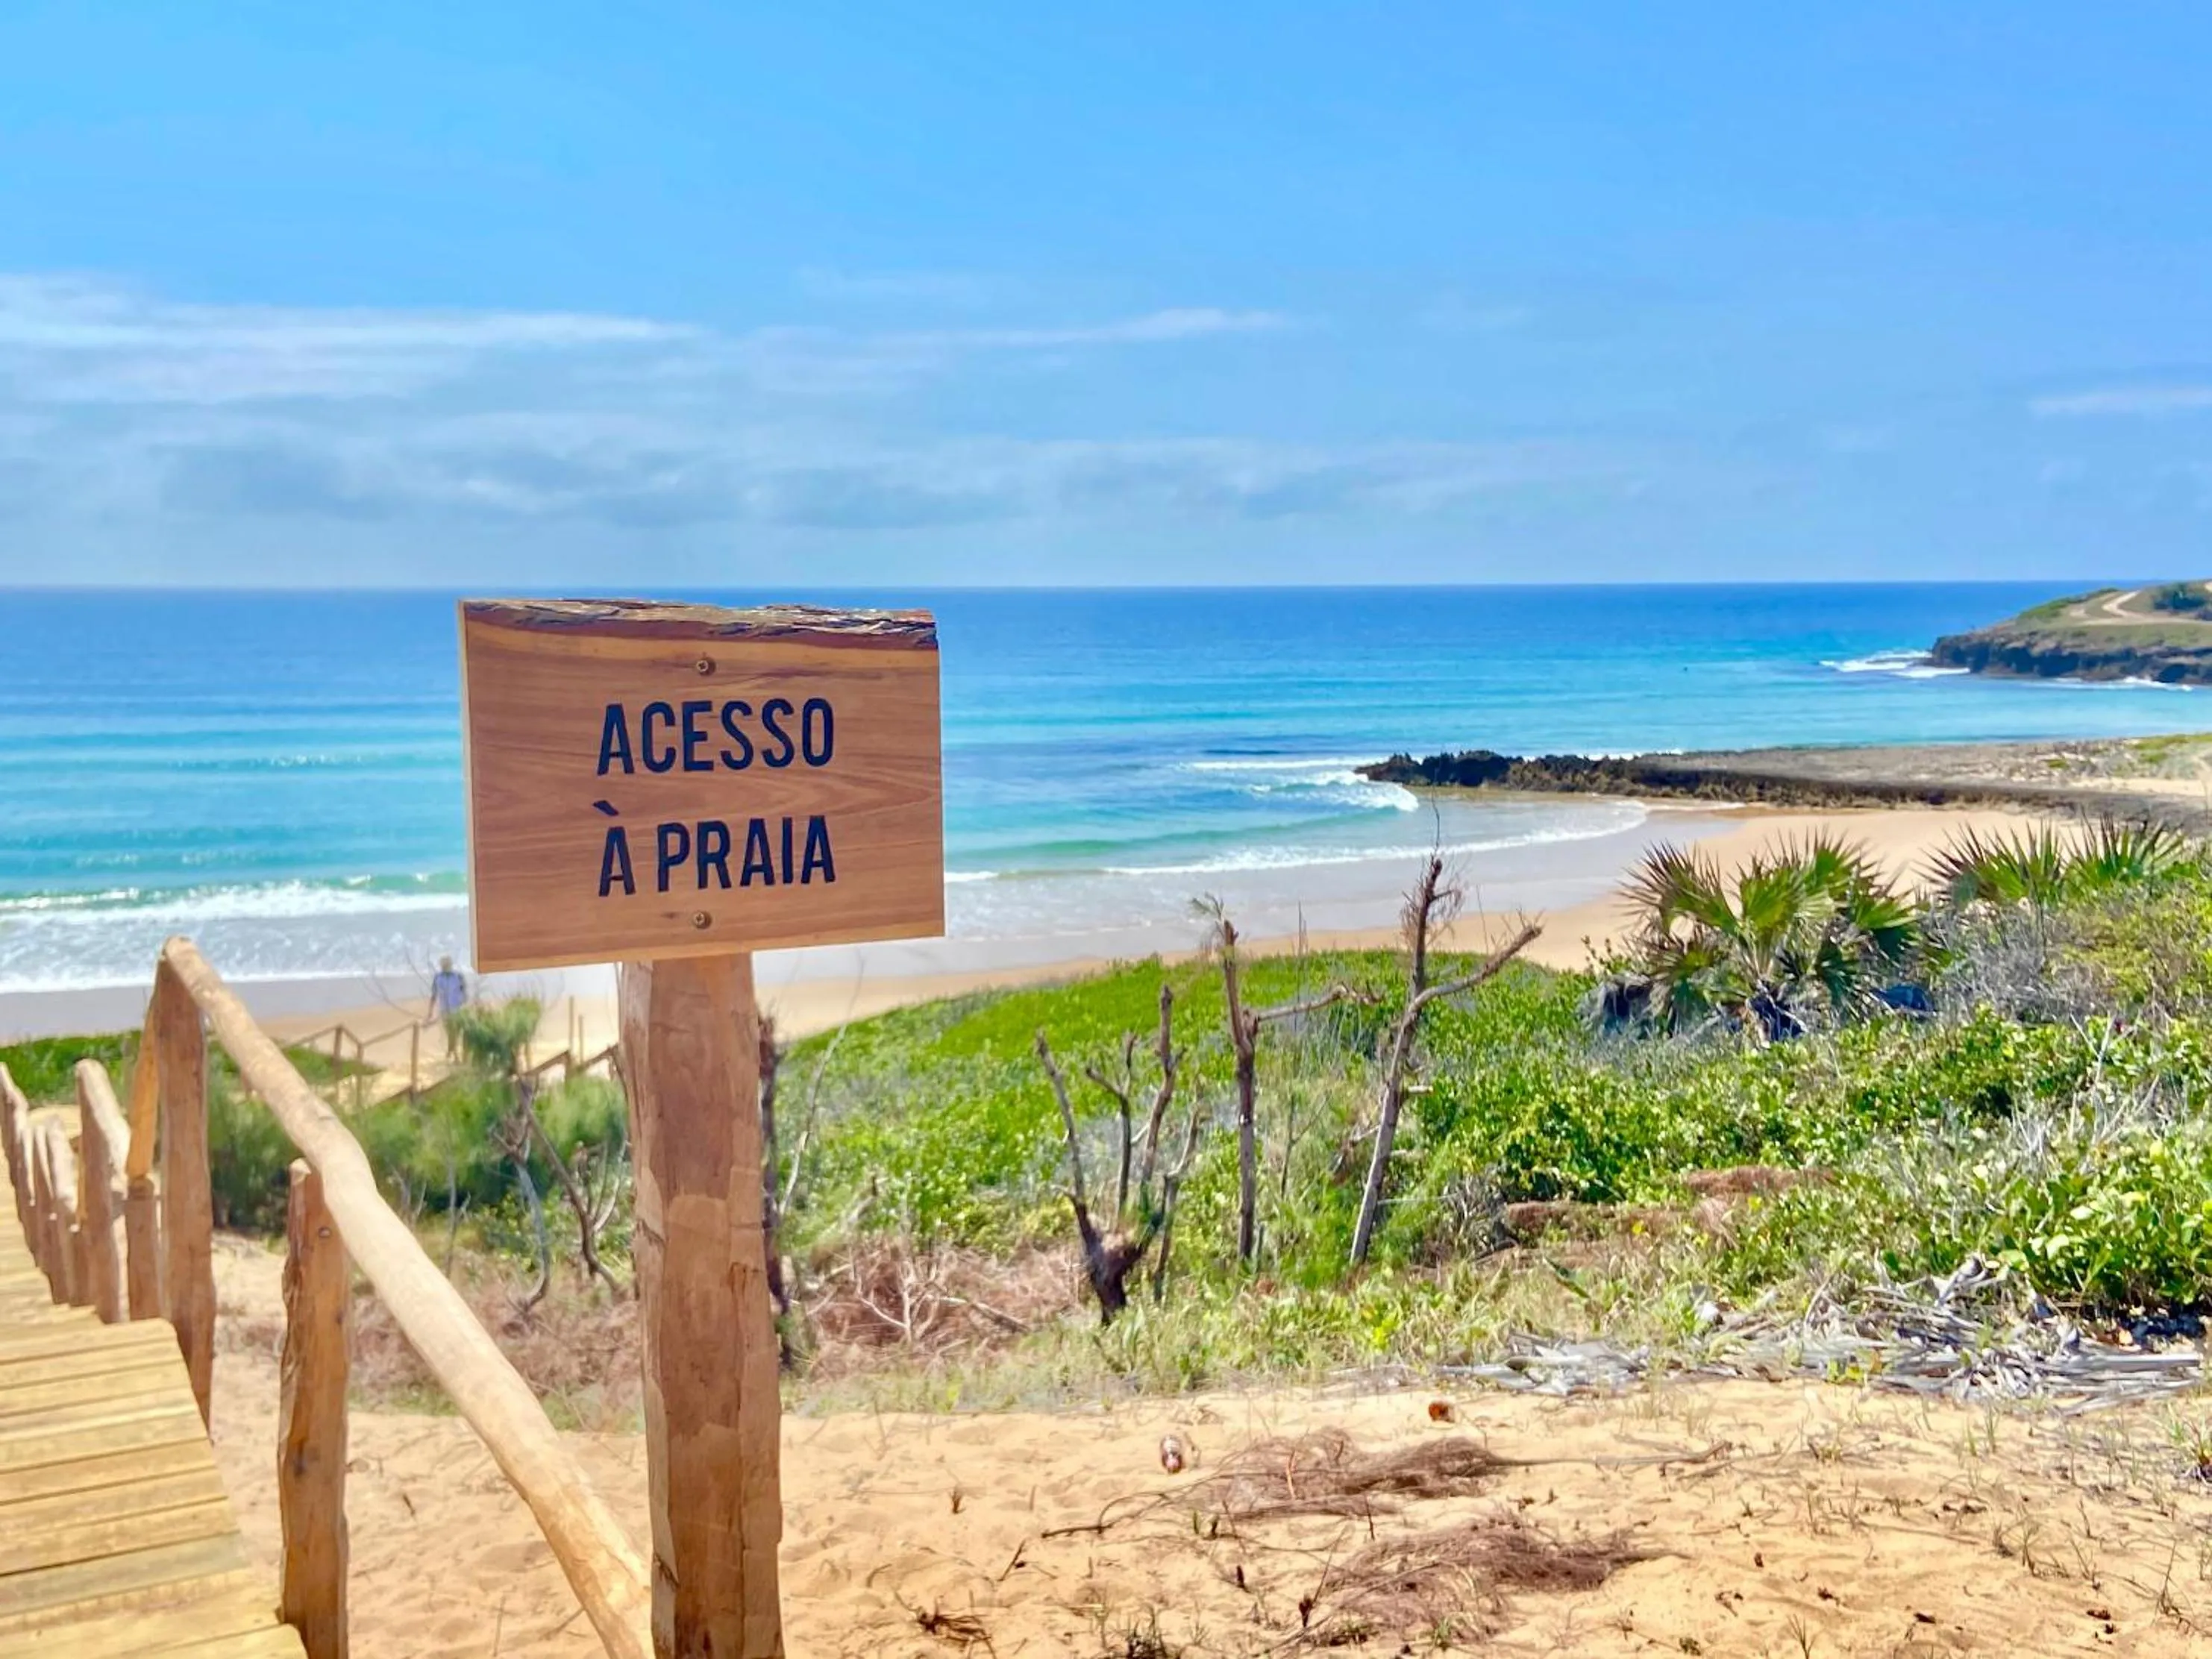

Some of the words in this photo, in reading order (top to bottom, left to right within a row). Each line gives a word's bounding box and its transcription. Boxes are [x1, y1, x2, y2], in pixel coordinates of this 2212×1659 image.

[597, 697, 834, 776] ACESSO
[593, 800, 636, 897] À
[657, 815, 836, 893] PRAIA
